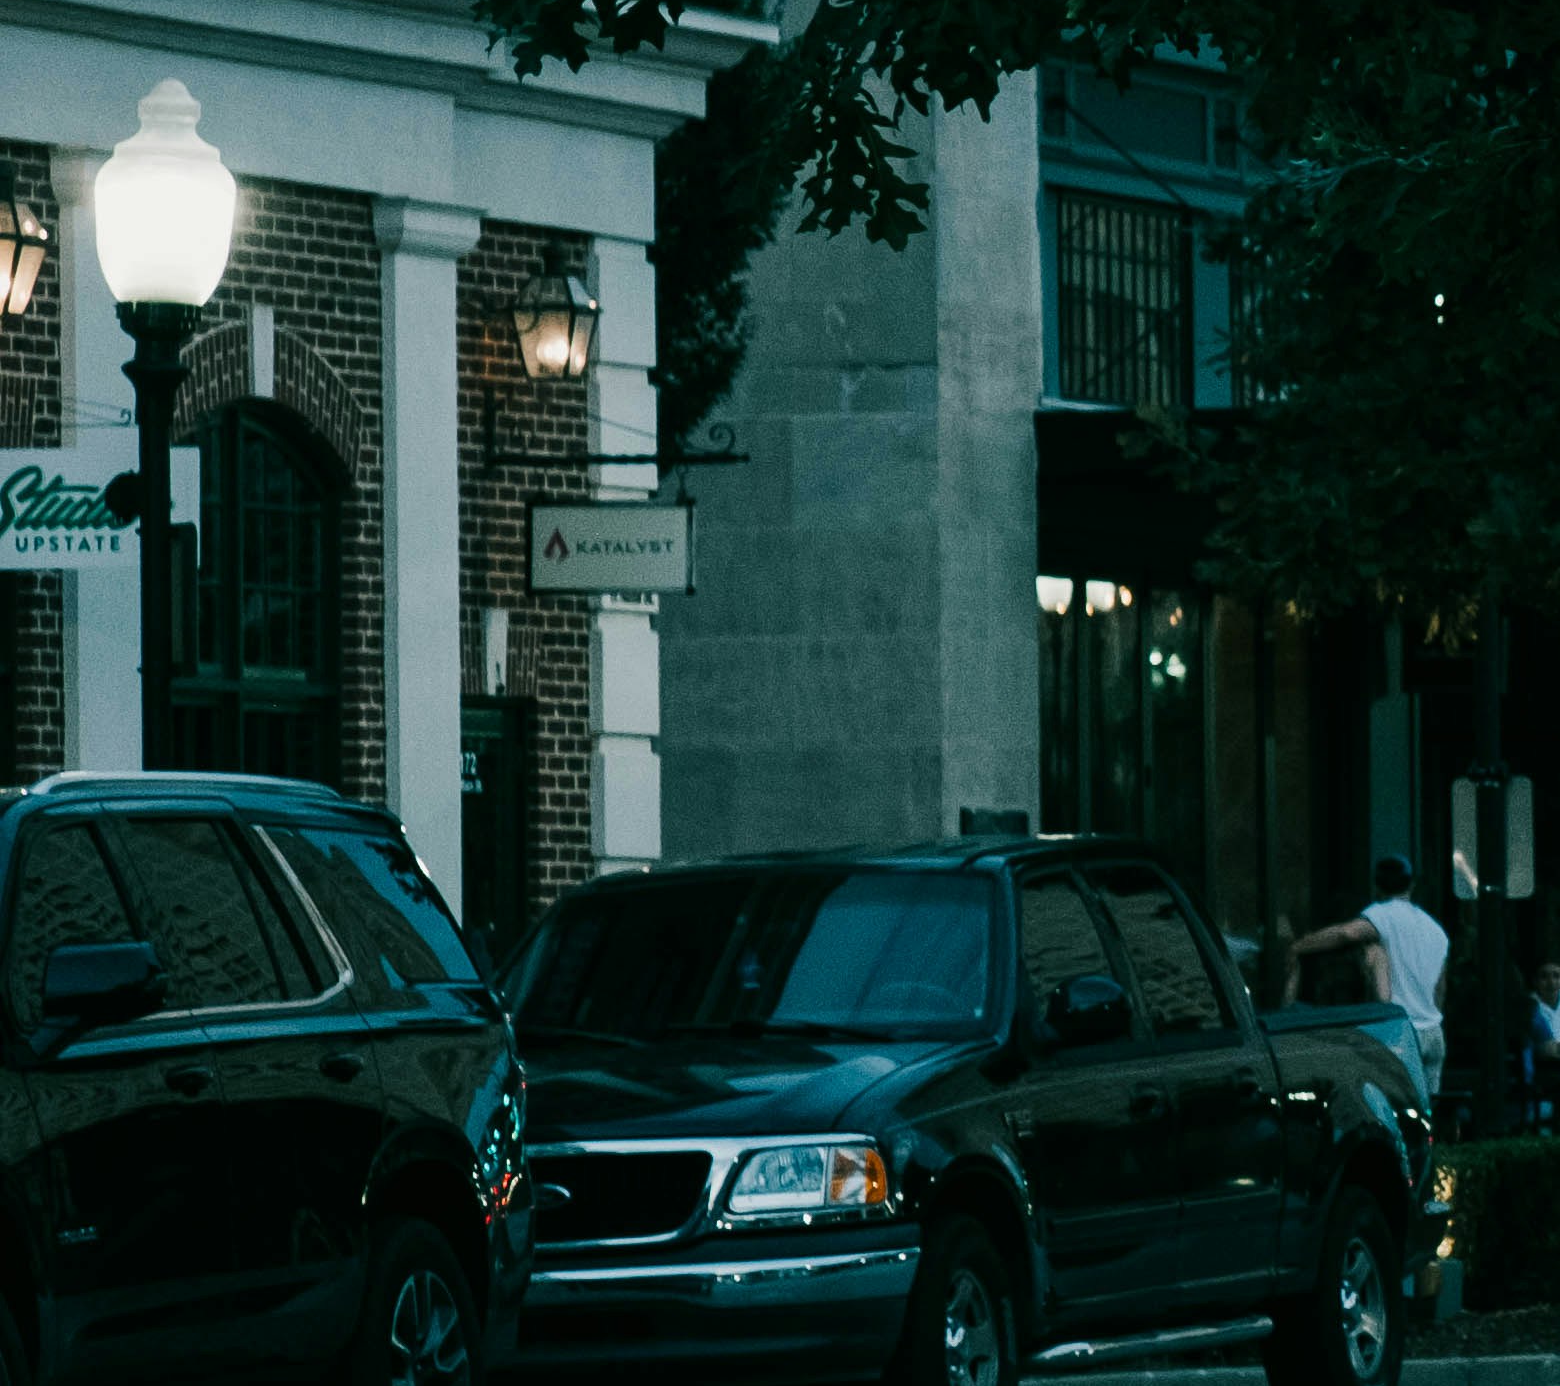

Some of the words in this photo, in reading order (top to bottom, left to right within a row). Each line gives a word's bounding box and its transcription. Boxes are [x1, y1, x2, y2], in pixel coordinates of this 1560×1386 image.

[0, 466, 141, 536] Studi
[15, 535, 120, 552] UPSTATE
[576, 539, 674, 554] KATALYST
